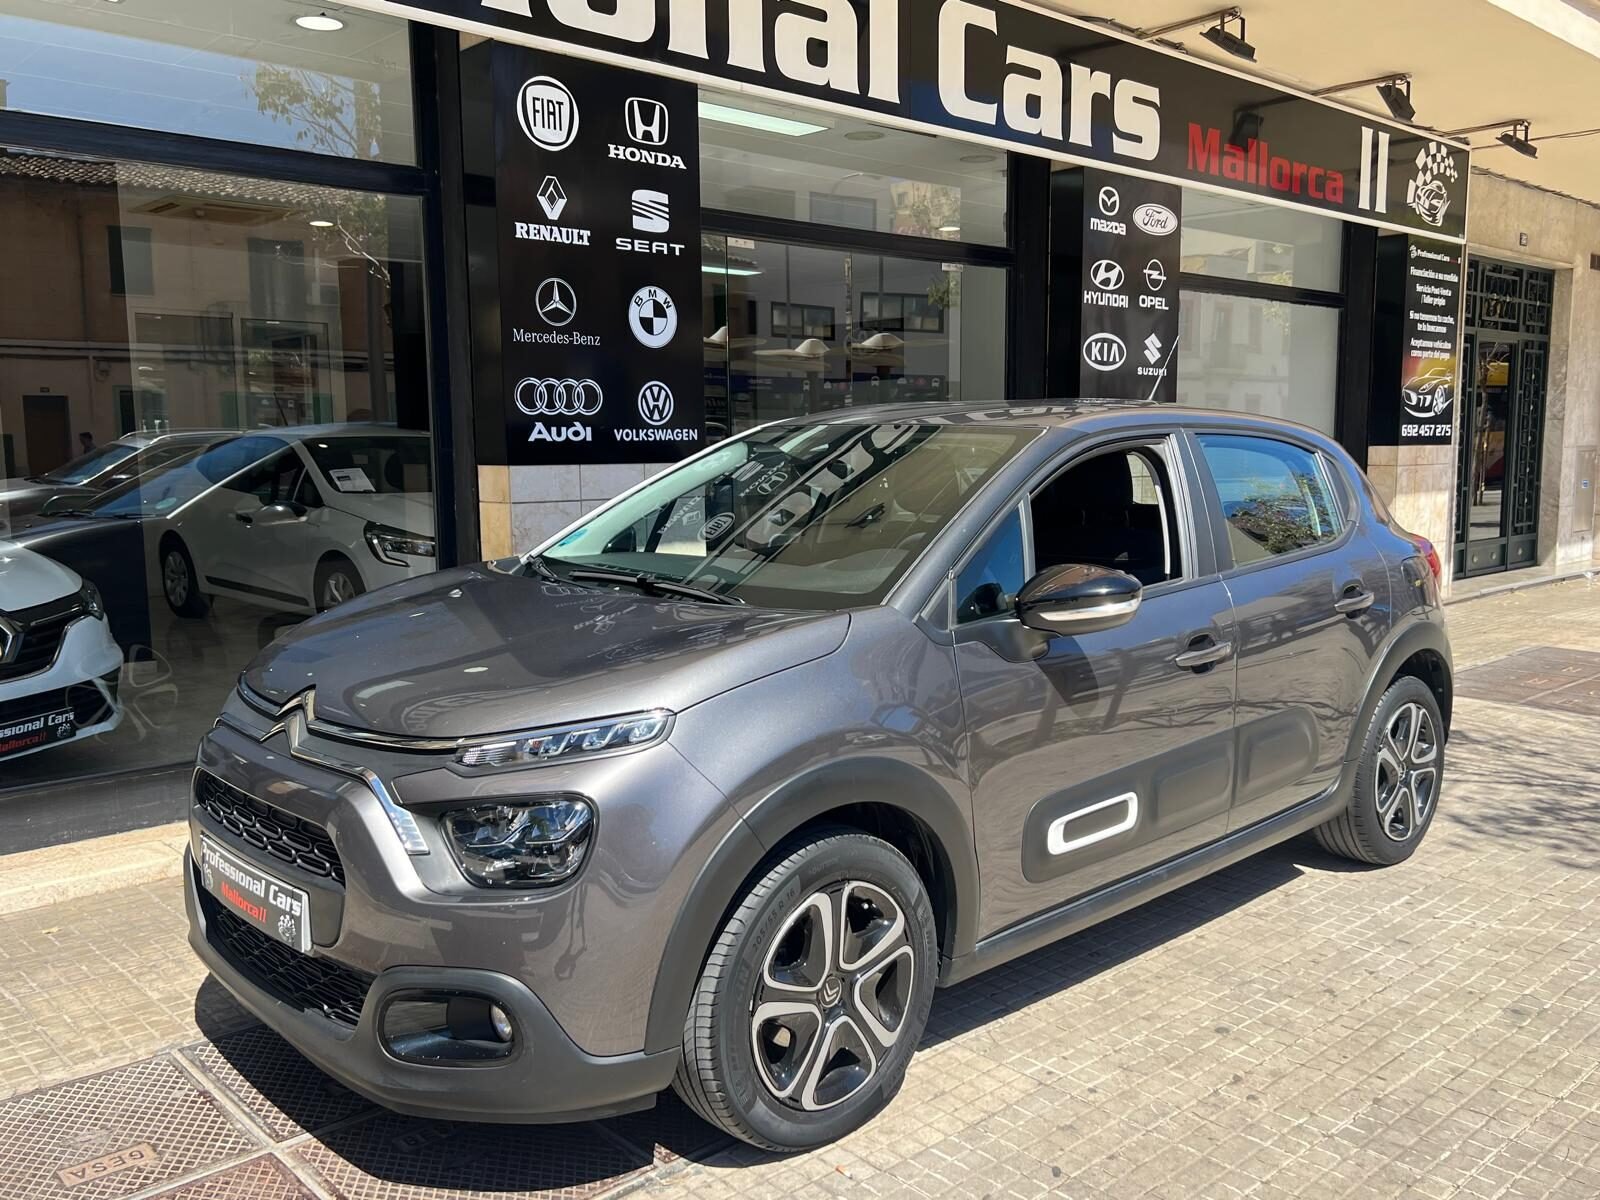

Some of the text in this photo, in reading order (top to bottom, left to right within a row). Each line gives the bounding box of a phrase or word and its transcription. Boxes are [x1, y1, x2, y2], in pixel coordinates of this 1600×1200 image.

[938, 0, 1161, 161] Cars
[1187, 122, 1344, 204] Mallorca
[532, 96, 564, 131] FIAT
[608, 143, 687, 170] HONDA
[1143, 208, 1168, 230] Ford
[515, 221, 591, 246] RENAULT
[615, 237, 686, 256] SEAT
[634, 289, 672, 310] BMW
[1083, 290, 1129, 309] HYUNDAI
[1138, 295, 1169, 310] OPEL
[513, 327, 601, 346] Mercedes-Benz
[1091, 341, 1120, 362] KIA
[528, 421, 592, 442] Audi
[614, 428, 698, 442] VOLKSWAGEN
[1401, 424, 1451, 437] 692 457 275
[47, 711, 75, 726] Cars
[268, 884, 302, 917] Cars
[69, 1150, 146, 1180] GESA
